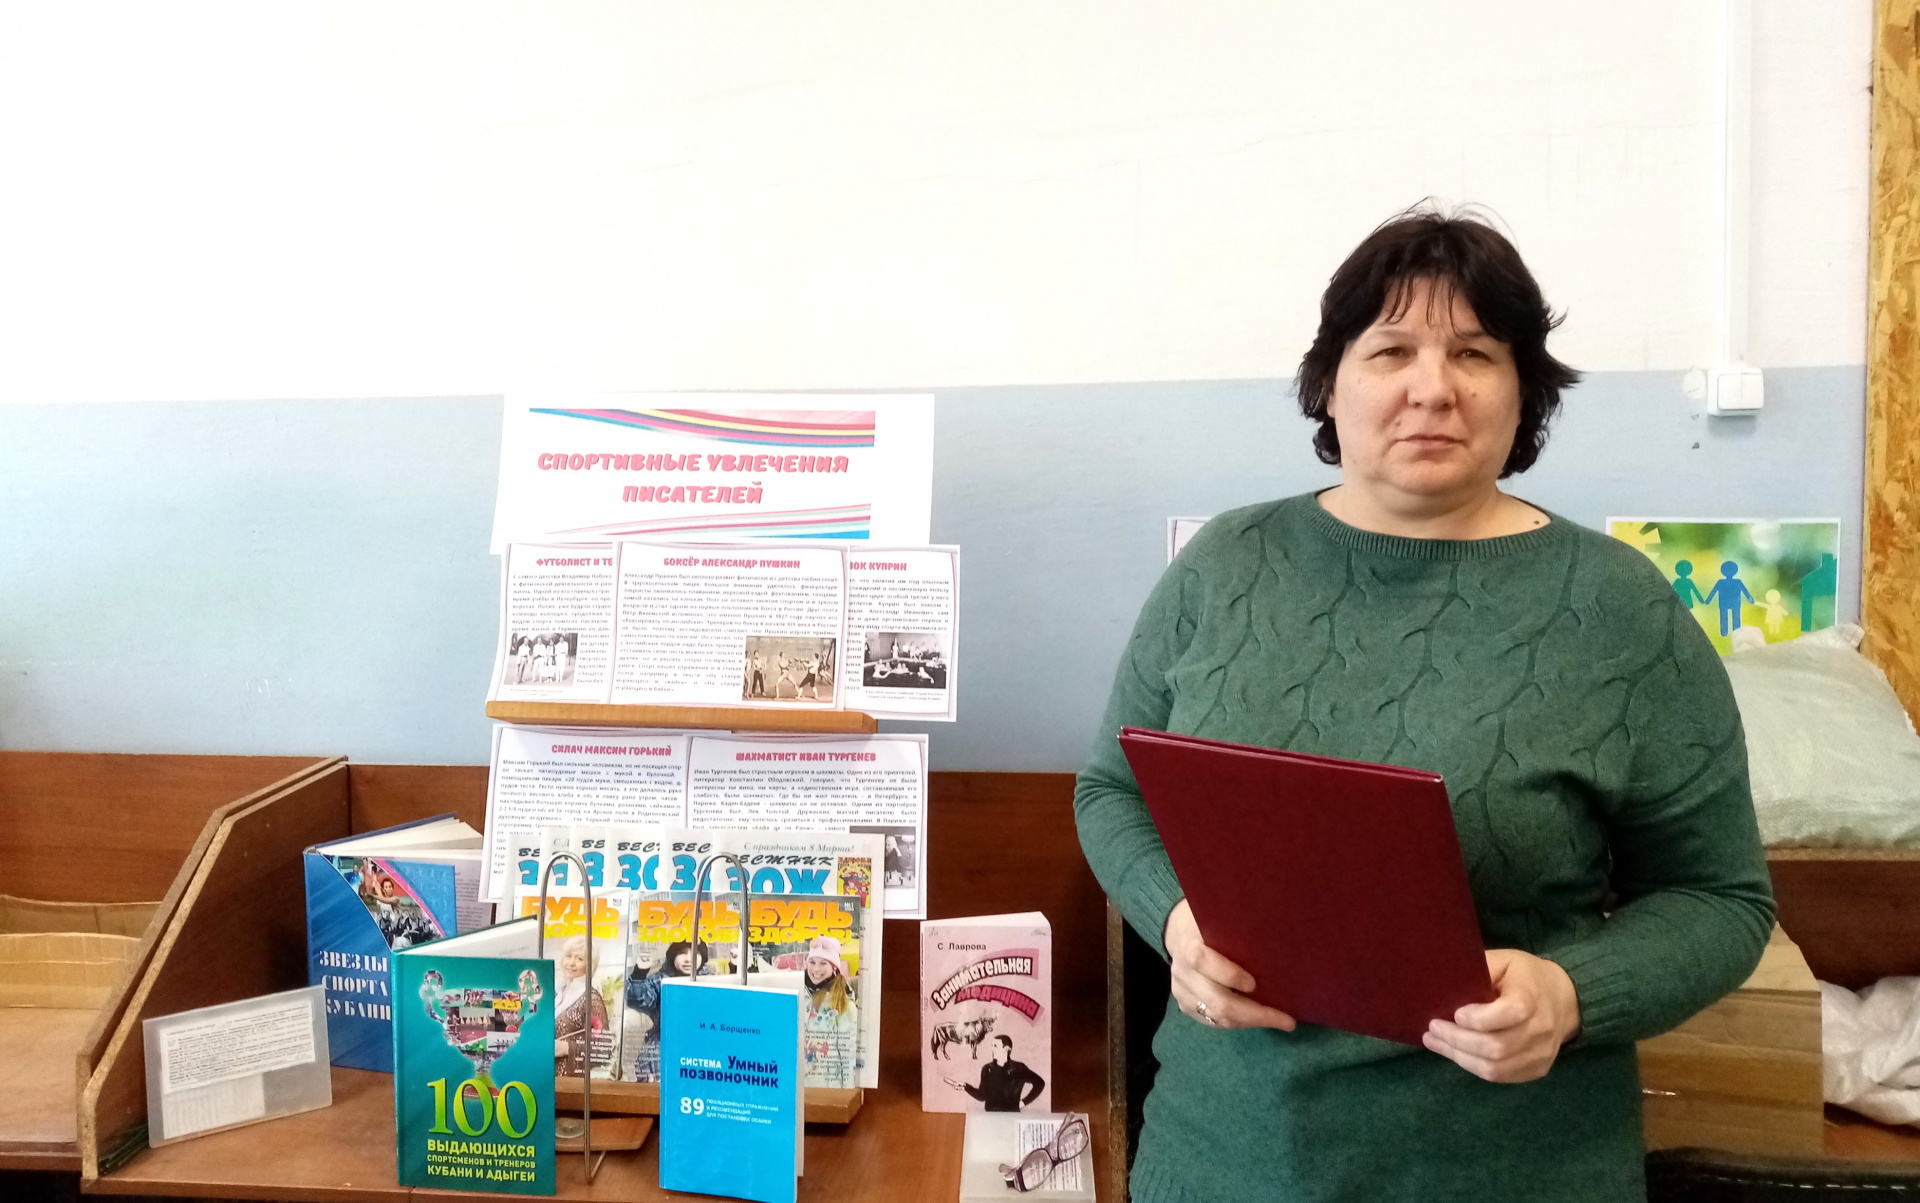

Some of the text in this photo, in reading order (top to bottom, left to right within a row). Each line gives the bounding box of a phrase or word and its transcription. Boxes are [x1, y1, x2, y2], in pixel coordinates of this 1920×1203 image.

[537, 453, 849, 474] СПОРТИВНЫЕ УВЛЕЧЕНИЯ
[621, 481, 763, 504] ПИСАТЕЛЕЙ
[536, 558, 591, 567] ФУТБОЛИСТ
[594, 558, 600, 567] И
[663, 556, 800, 569] БОКСЁР АЛЕКСАНДР ПУШКИН
[869, 562, 907, 571] КУПРИН
[551, 744, 672, 757] СИЛАЧ МАКСИМ ГОРЬКИЙ
[736, 752, 876, 762] ШАХМАТИСТ ИВАН ТУРГЕНЕВ
[526, 760, 550, 768] Горький
[744, 843, 855, 854] С праздником 8 Марта!
[725, 867, 830, 895] ЗОЖ
[638, 900, 740, 927] БУДЬ
[749, 899, 853, 929] БУДЬ
[949, 942, 987, 952] Лаврова
[319, 950, 388, 973] ЗВЕЗДЫ
[321, 974, 388, 996] СПОРТА
[932, 956, 1034, 1011] Занимательная
[720, 1024, 761, 1036] Борщенко
[728, 1055, 778, 1075] Умный
[427, 1078, 538, 1139] 100
[680, 1096, 705, 1116] 89
[427, 1139, 535, 1158] ВЫДАЮЩИХСЯ
[427, 1154, 535, 1169] СПОРТСМЕНОВ И ТРЕНЕРОВ
[427, 1165, 535, 1182] КУБАНИ И АДЫГЕИ
